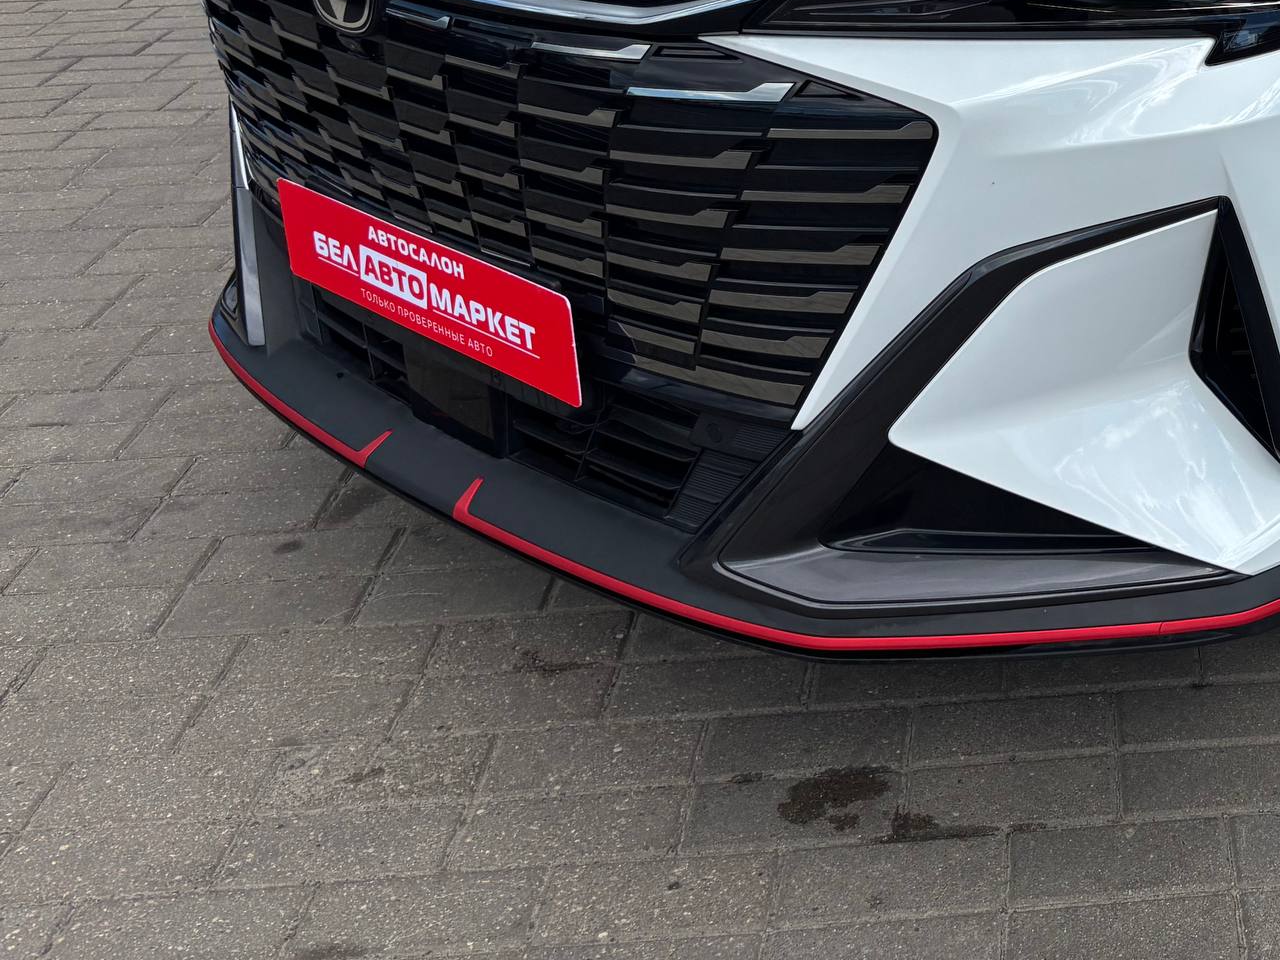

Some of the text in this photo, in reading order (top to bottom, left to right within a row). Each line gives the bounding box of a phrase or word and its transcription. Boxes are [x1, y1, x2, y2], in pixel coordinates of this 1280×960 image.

[368, 226, 465, 280] АВТОСАЛОН
[360, 287, 494, 358] ТОЛЬКО ПРОВЕРЕННЫЕ АВТО
